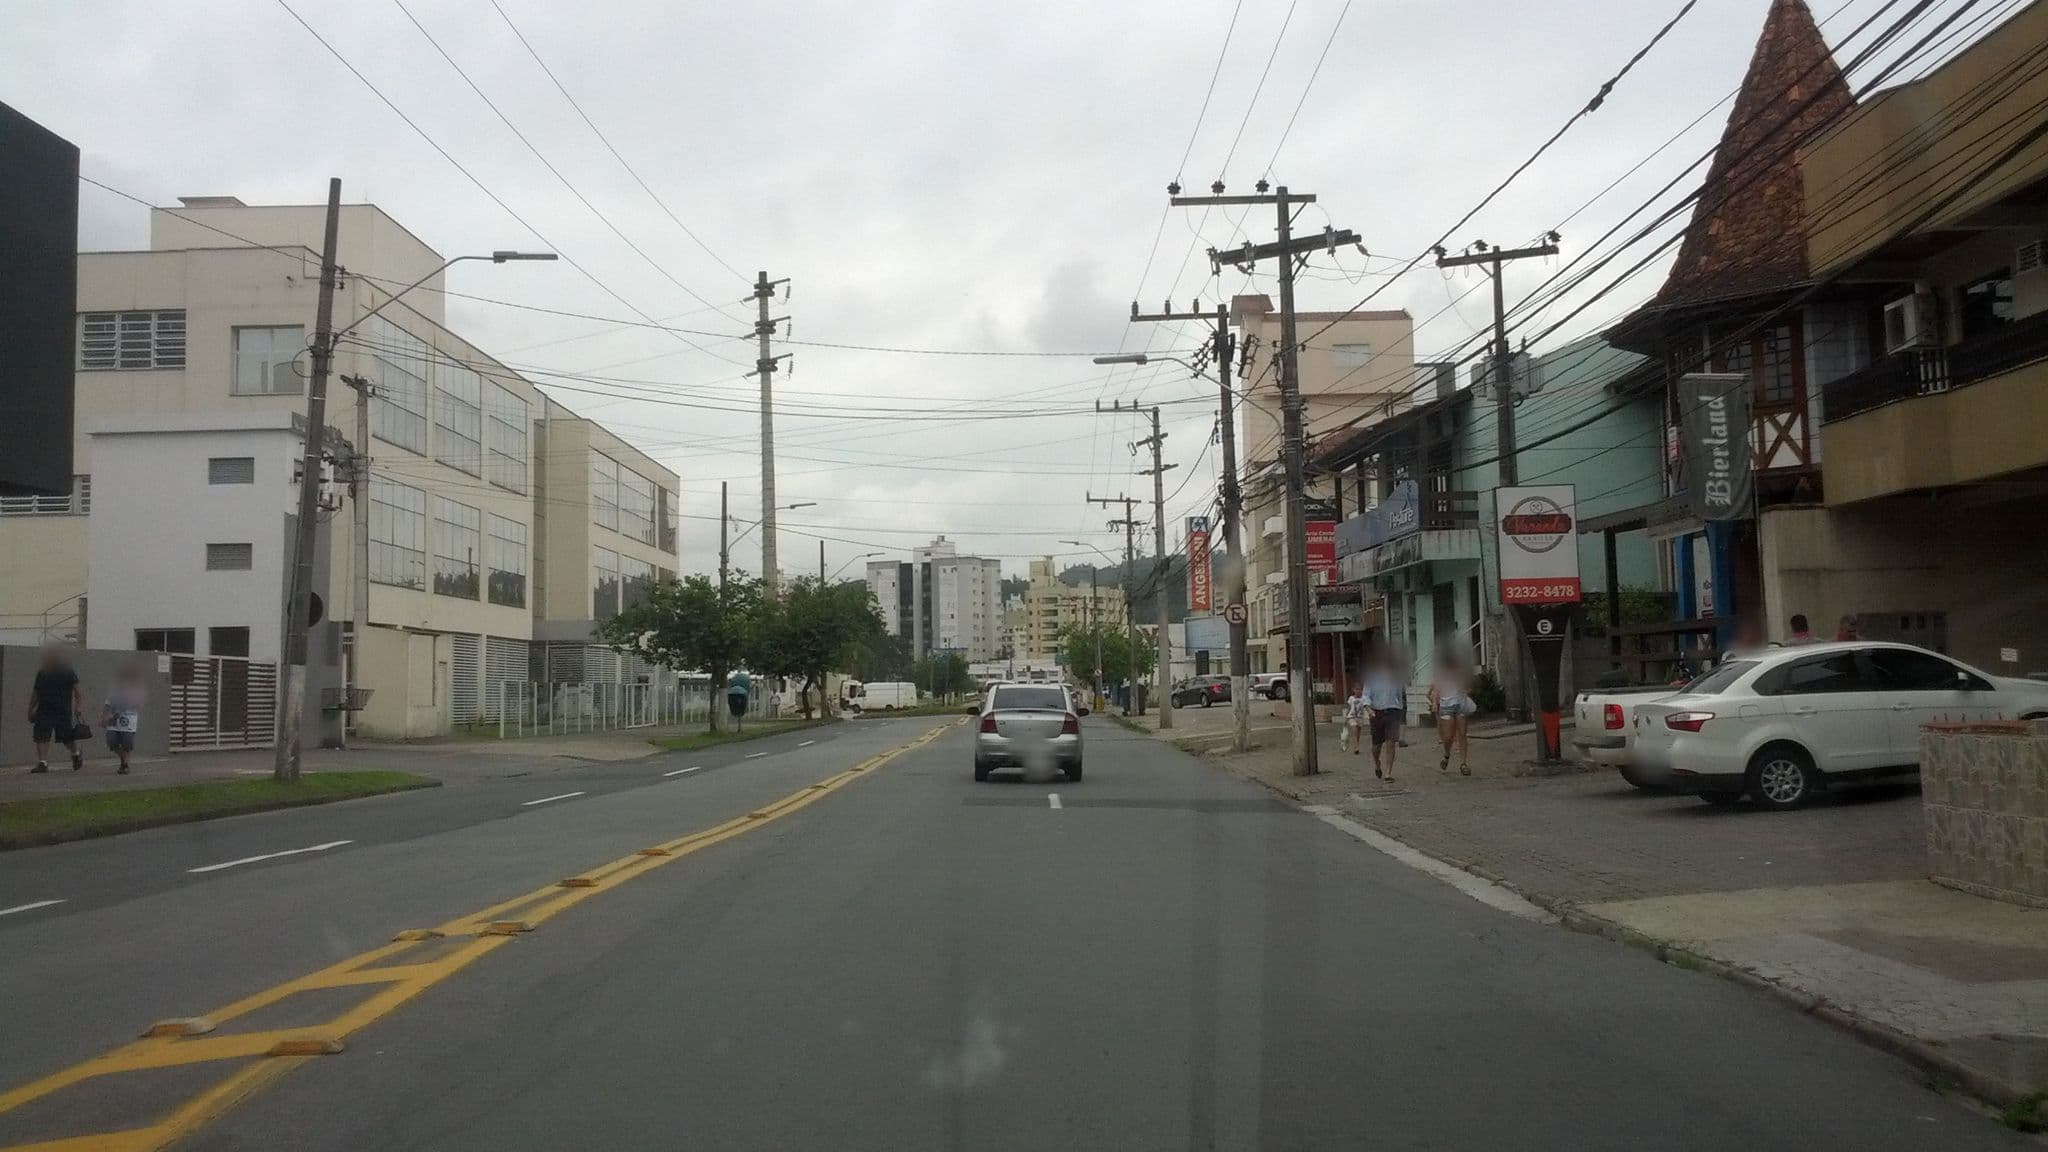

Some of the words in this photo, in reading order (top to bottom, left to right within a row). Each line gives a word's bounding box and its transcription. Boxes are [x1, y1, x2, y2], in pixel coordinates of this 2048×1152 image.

[1698, 395, 1732, 506] Bierland
[1506, 585, 1575, 599] 3232-8478
[1540, 621, 1548, 631] E
